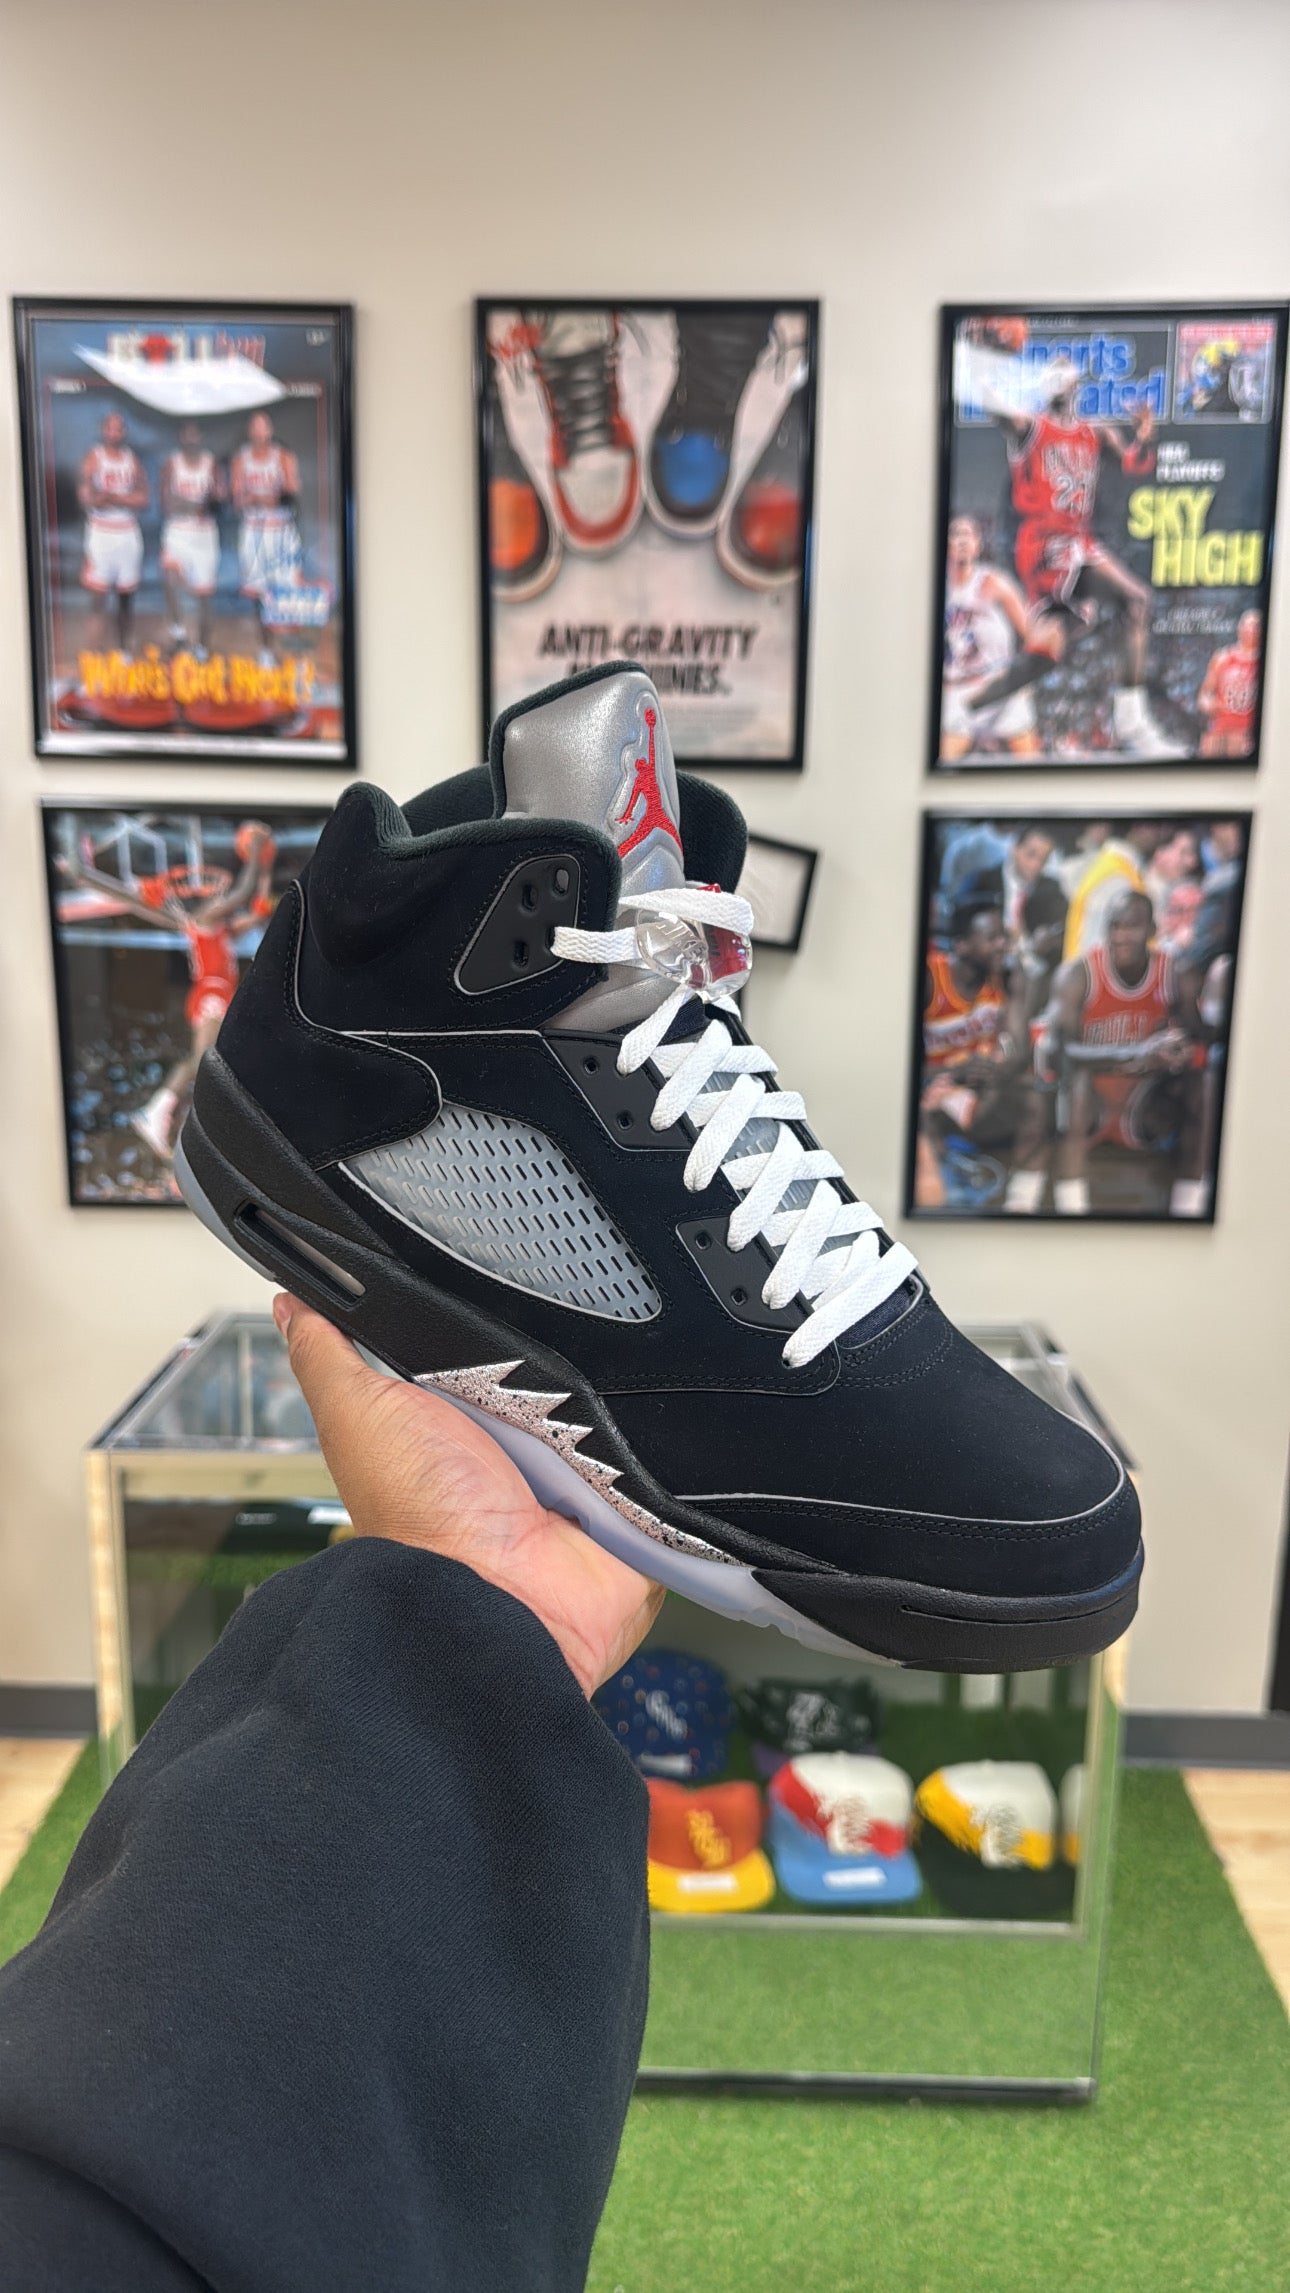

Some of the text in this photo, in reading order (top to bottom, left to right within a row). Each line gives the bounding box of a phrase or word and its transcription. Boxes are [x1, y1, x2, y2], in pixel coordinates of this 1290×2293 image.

[1128, 487, 1214, 539] SKY
[1153, 530, 1263, 587] HIGH
[538, 623, 758, 658] ANTI-GRAVITY
